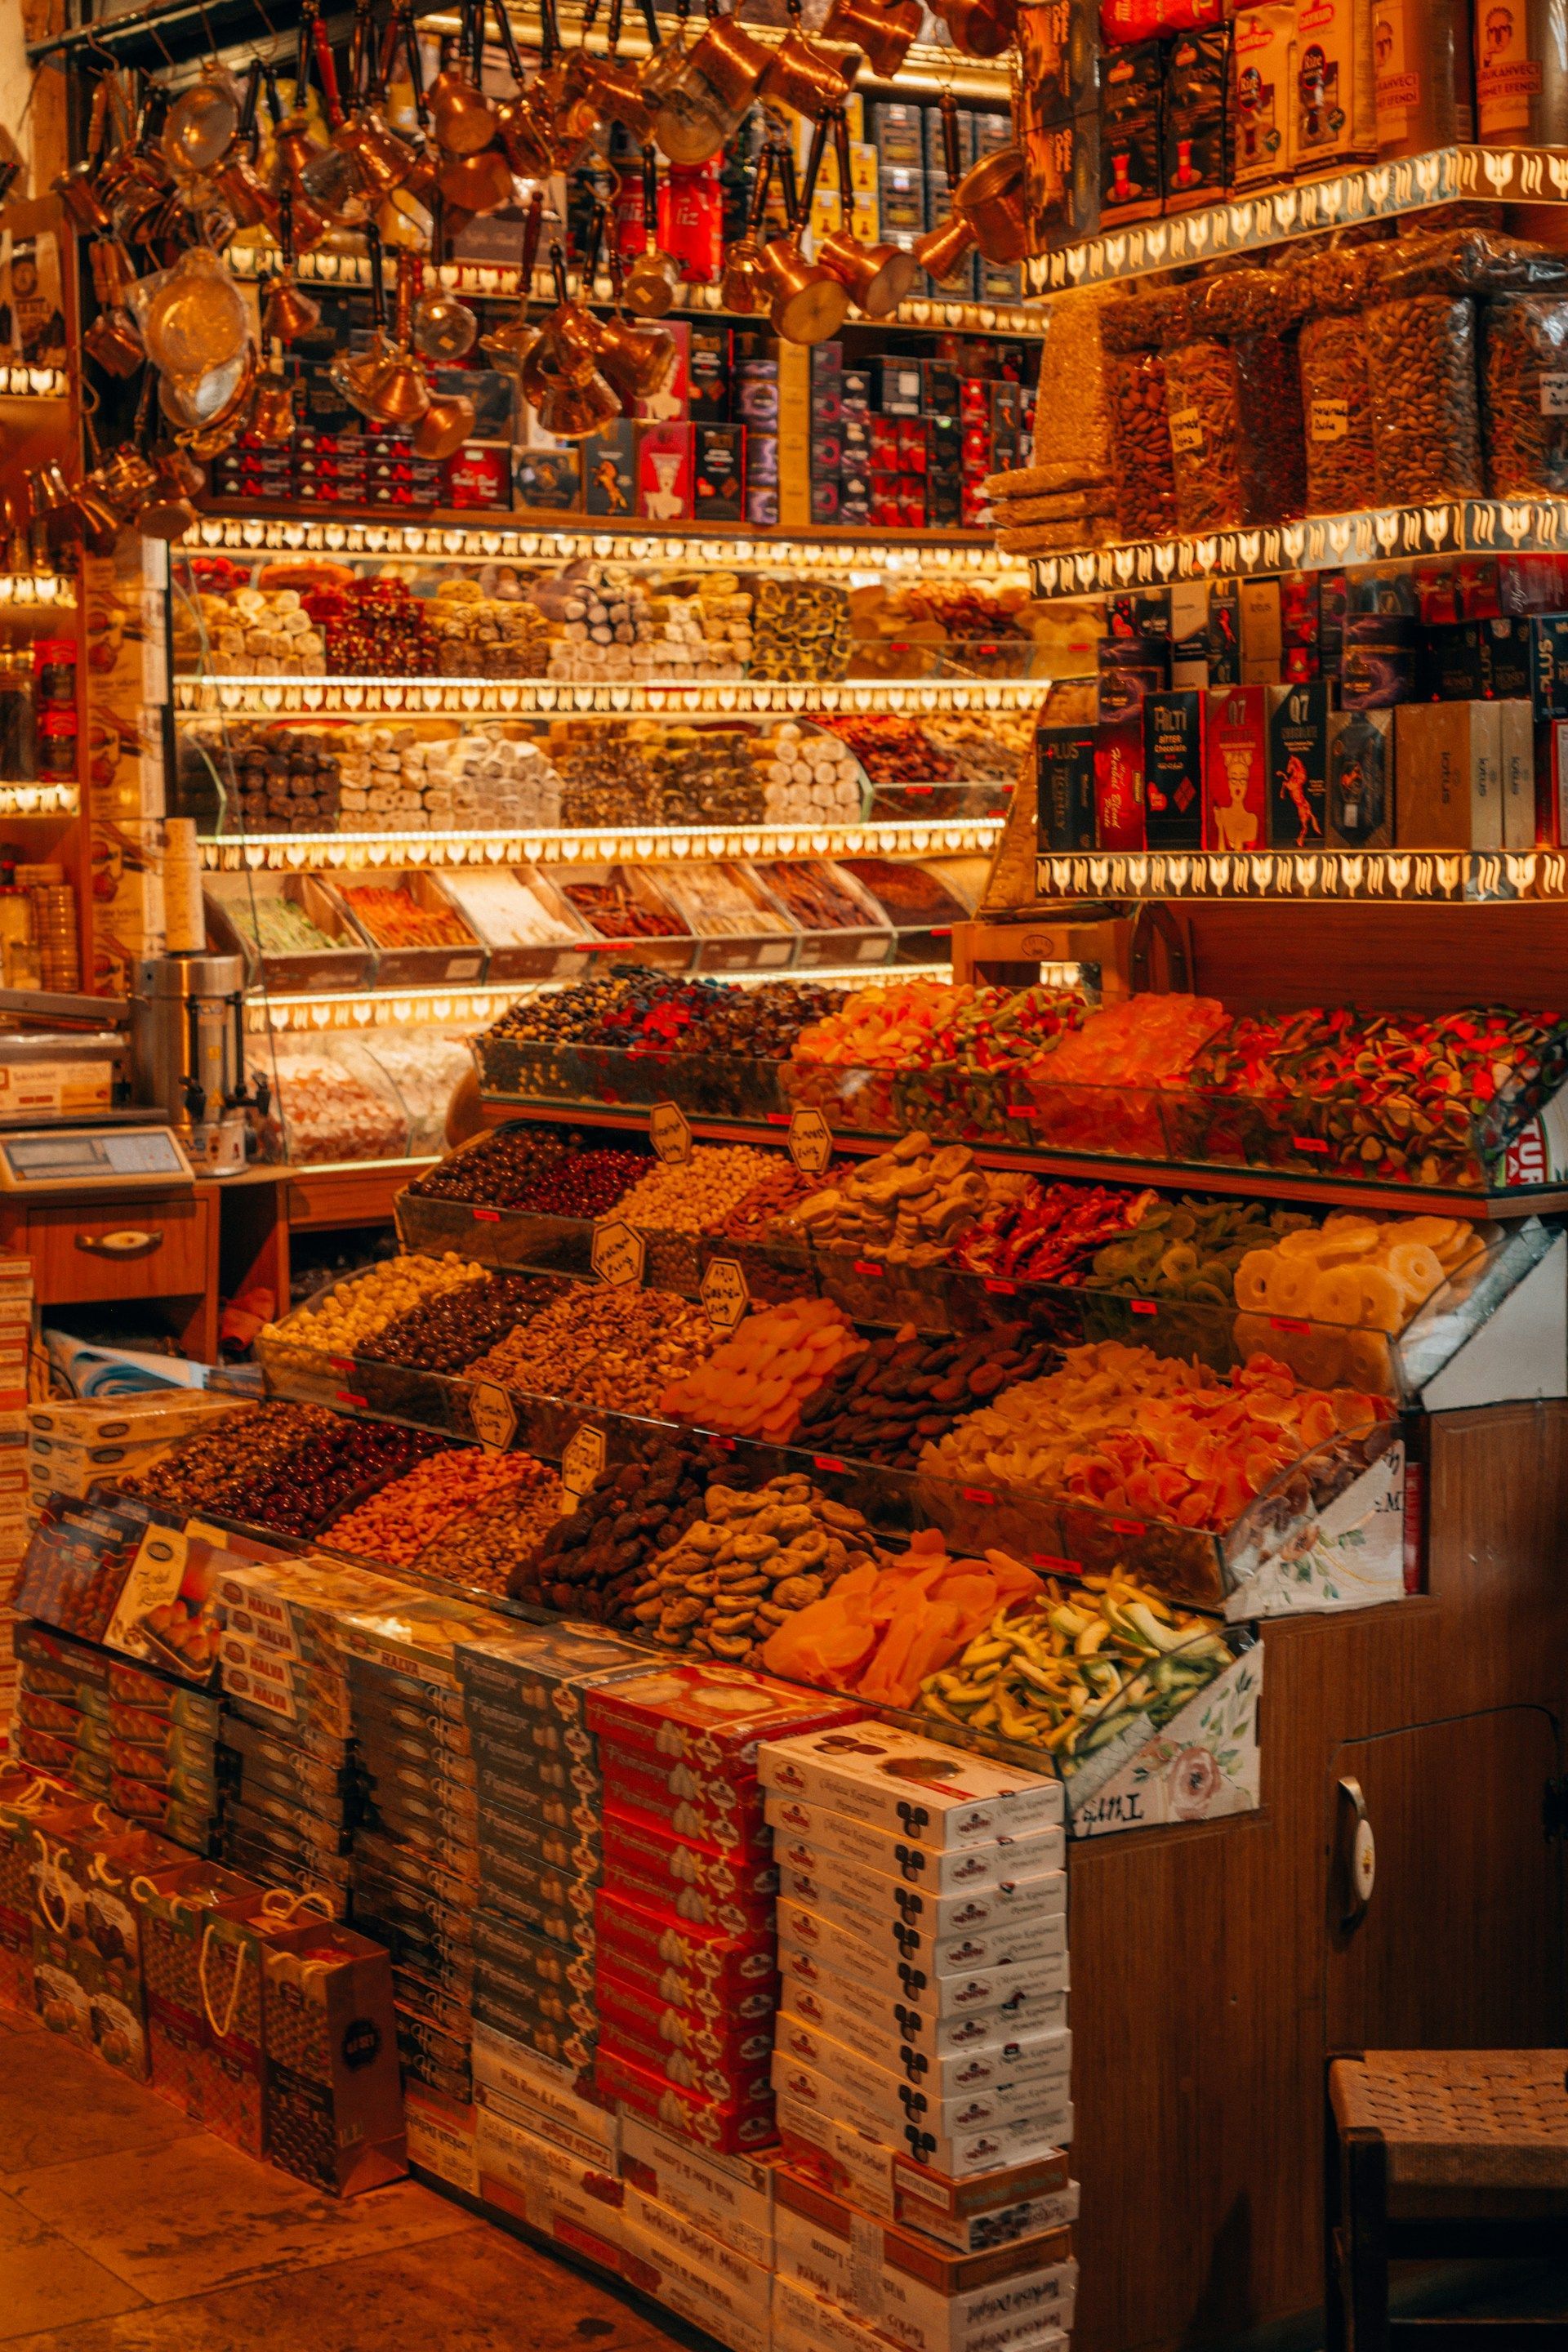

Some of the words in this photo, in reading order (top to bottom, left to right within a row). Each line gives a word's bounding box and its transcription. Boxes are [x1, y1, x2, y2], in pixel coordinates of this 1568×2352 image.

[1289, 694, 1310, 725] Q7
[247, 1597, 282, 1622] HALVA
[249, 1655, 285, 1682] HALVA
[252, 1684, 287, 1712] HALVA
